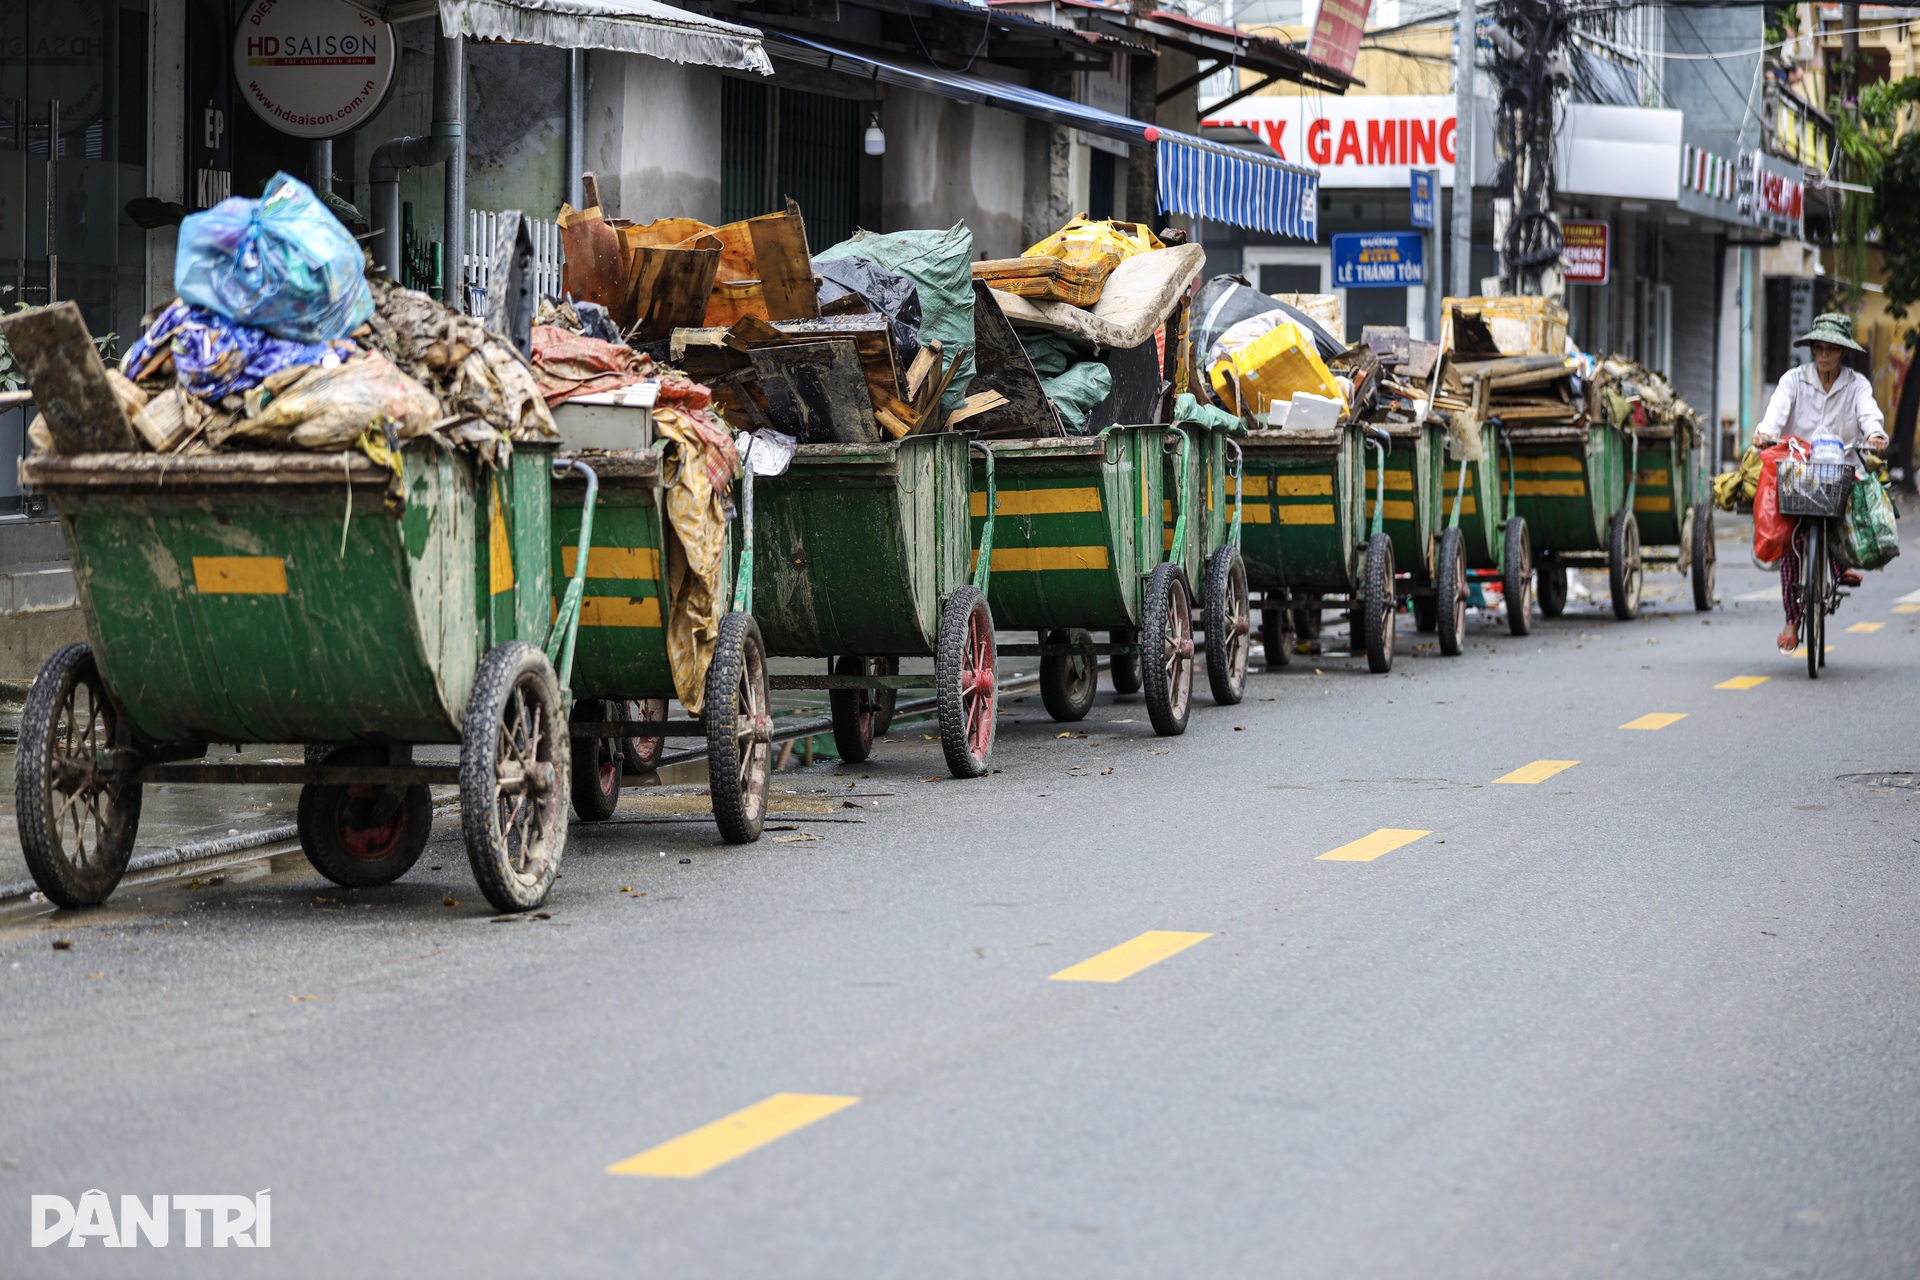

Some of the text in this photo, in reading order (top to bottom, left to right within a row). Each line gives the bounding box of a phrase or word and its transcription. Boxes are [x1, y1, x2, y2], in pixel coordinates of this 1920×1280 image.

[247, 35, 376, 57] HD SAISON
[205, 99, 224, 150] ÉP
[249, 80, 375, 125] www.hdsaison.com.vn
[1307, 117, 1456, 166] GAMING
[197, 160, 231, 209] KÍNH
[1338, 259, 1421, 282] LÊ THÁNH TÔN
[1563, 261, 1602, 276] MING
